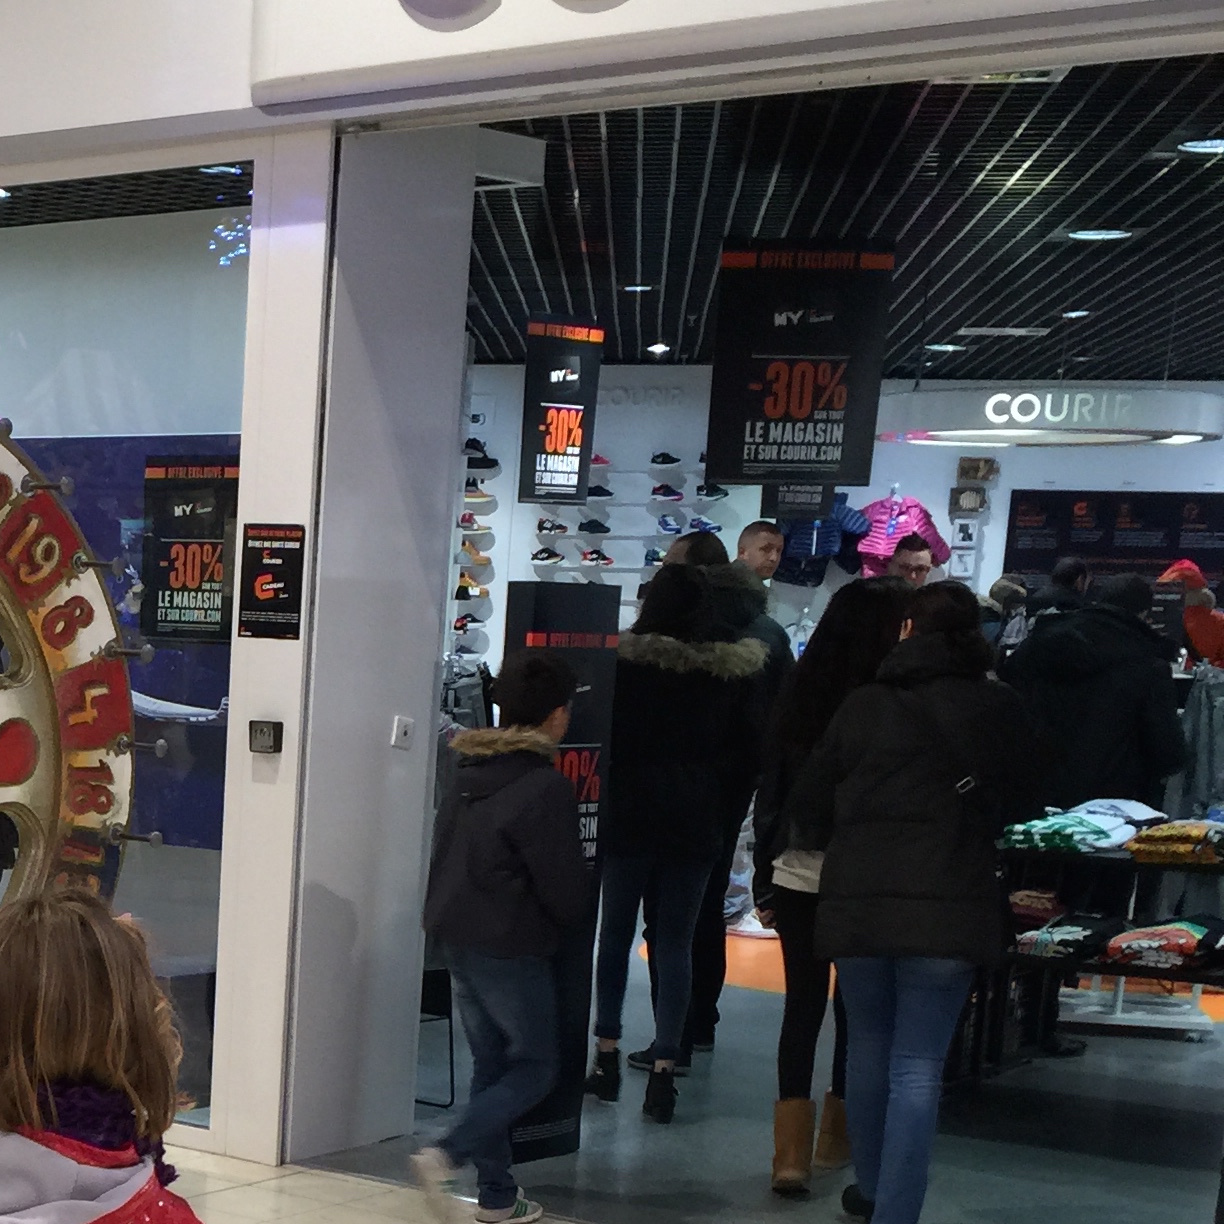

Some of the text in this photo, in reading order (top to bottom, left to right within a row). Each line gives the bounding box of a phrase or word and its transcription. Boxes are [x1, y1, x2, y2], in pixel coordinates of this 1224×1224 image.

[748, 361, 848, 420] -30%
[985, 393, 1133, 424] COURIR
[538, 408, 584, 454] -30%
[743, 420, 845, 444] LE MAGASIN
[743, 444, 843, 462] ET SUR COURIR.COM
[536, 453, 580, 473] LE MAGASIN
[5, 513, 62, 585] 19
[159, 543, 224, 589] -30%
[157, 590, 223, 609] LE MAGASIN
[157, 608, 222, 623] ET SUR COURIR.COM
[41, 595, 95, 650] 8
[67, 682, 111, 727] 4
[67, 758, 115, 816] 18
